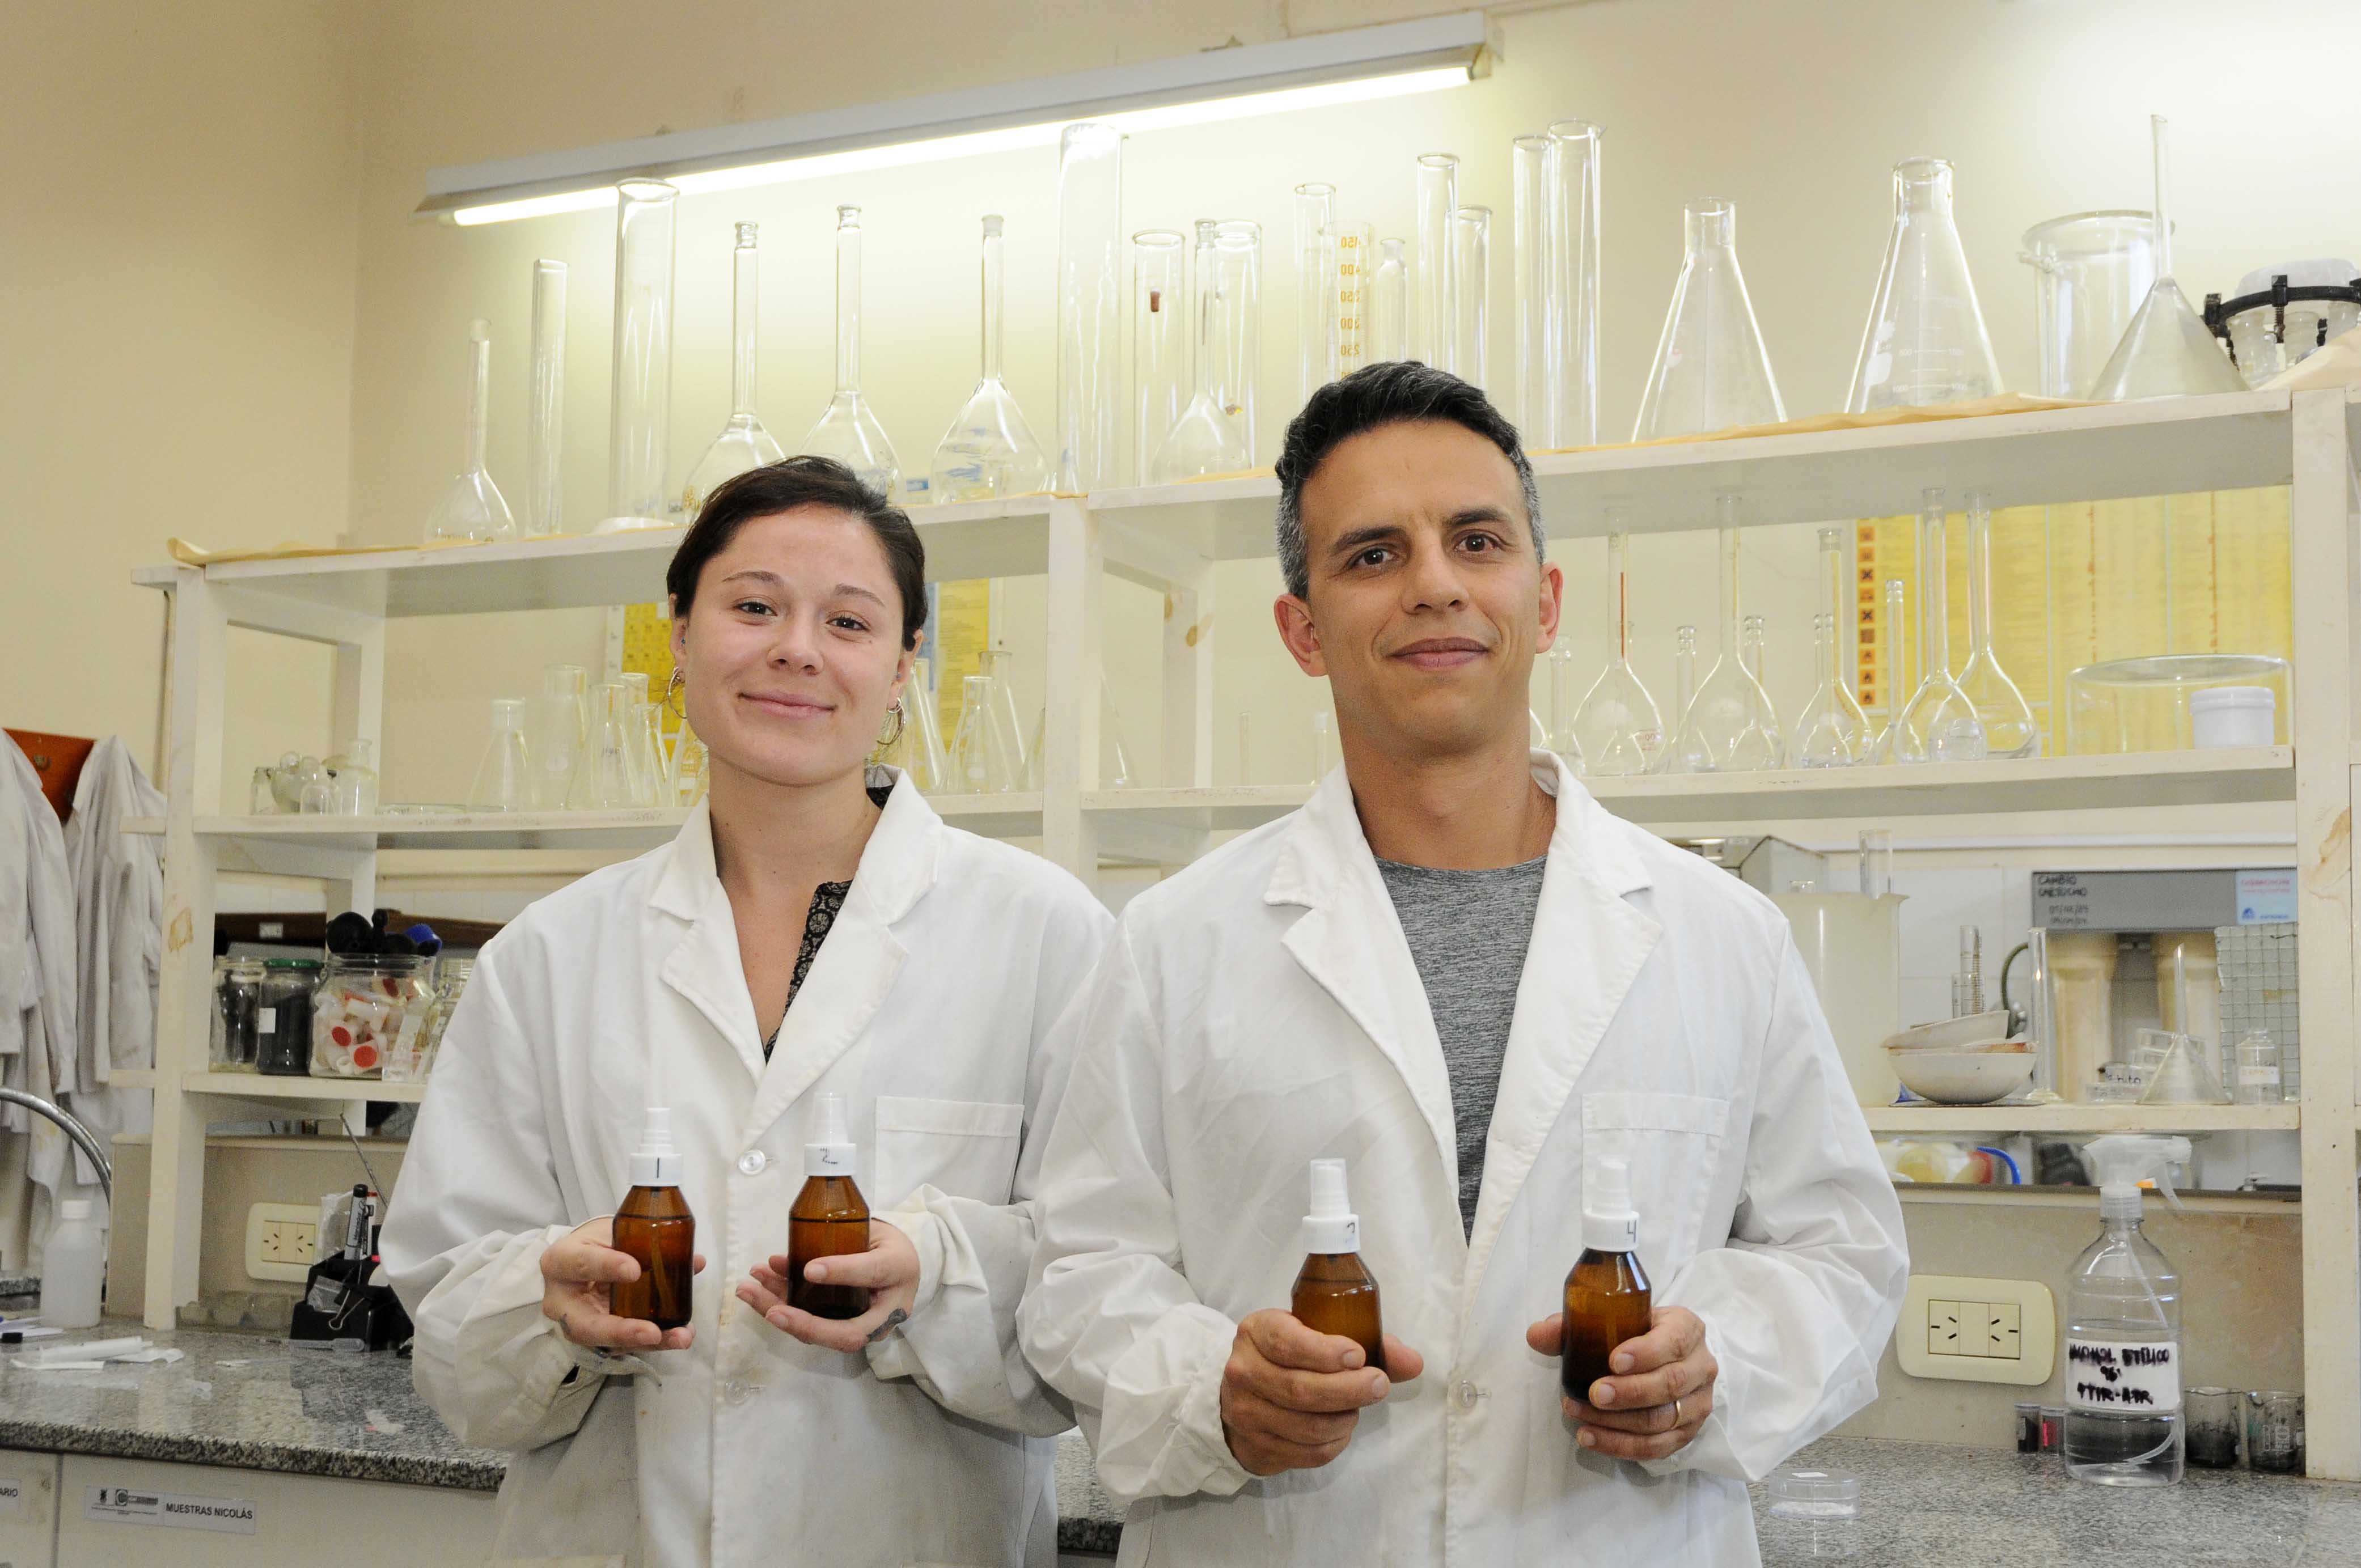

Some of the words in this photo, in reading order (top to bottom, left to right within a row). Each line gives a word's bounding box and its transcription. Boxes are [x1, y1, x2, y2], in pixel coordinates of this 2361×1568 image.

[1627, 1219, 1637, 1243] 4
[166, 1503, 212, 1516] MUESTRAS
[214, 1507, 253, 1519] NICOLÁS
